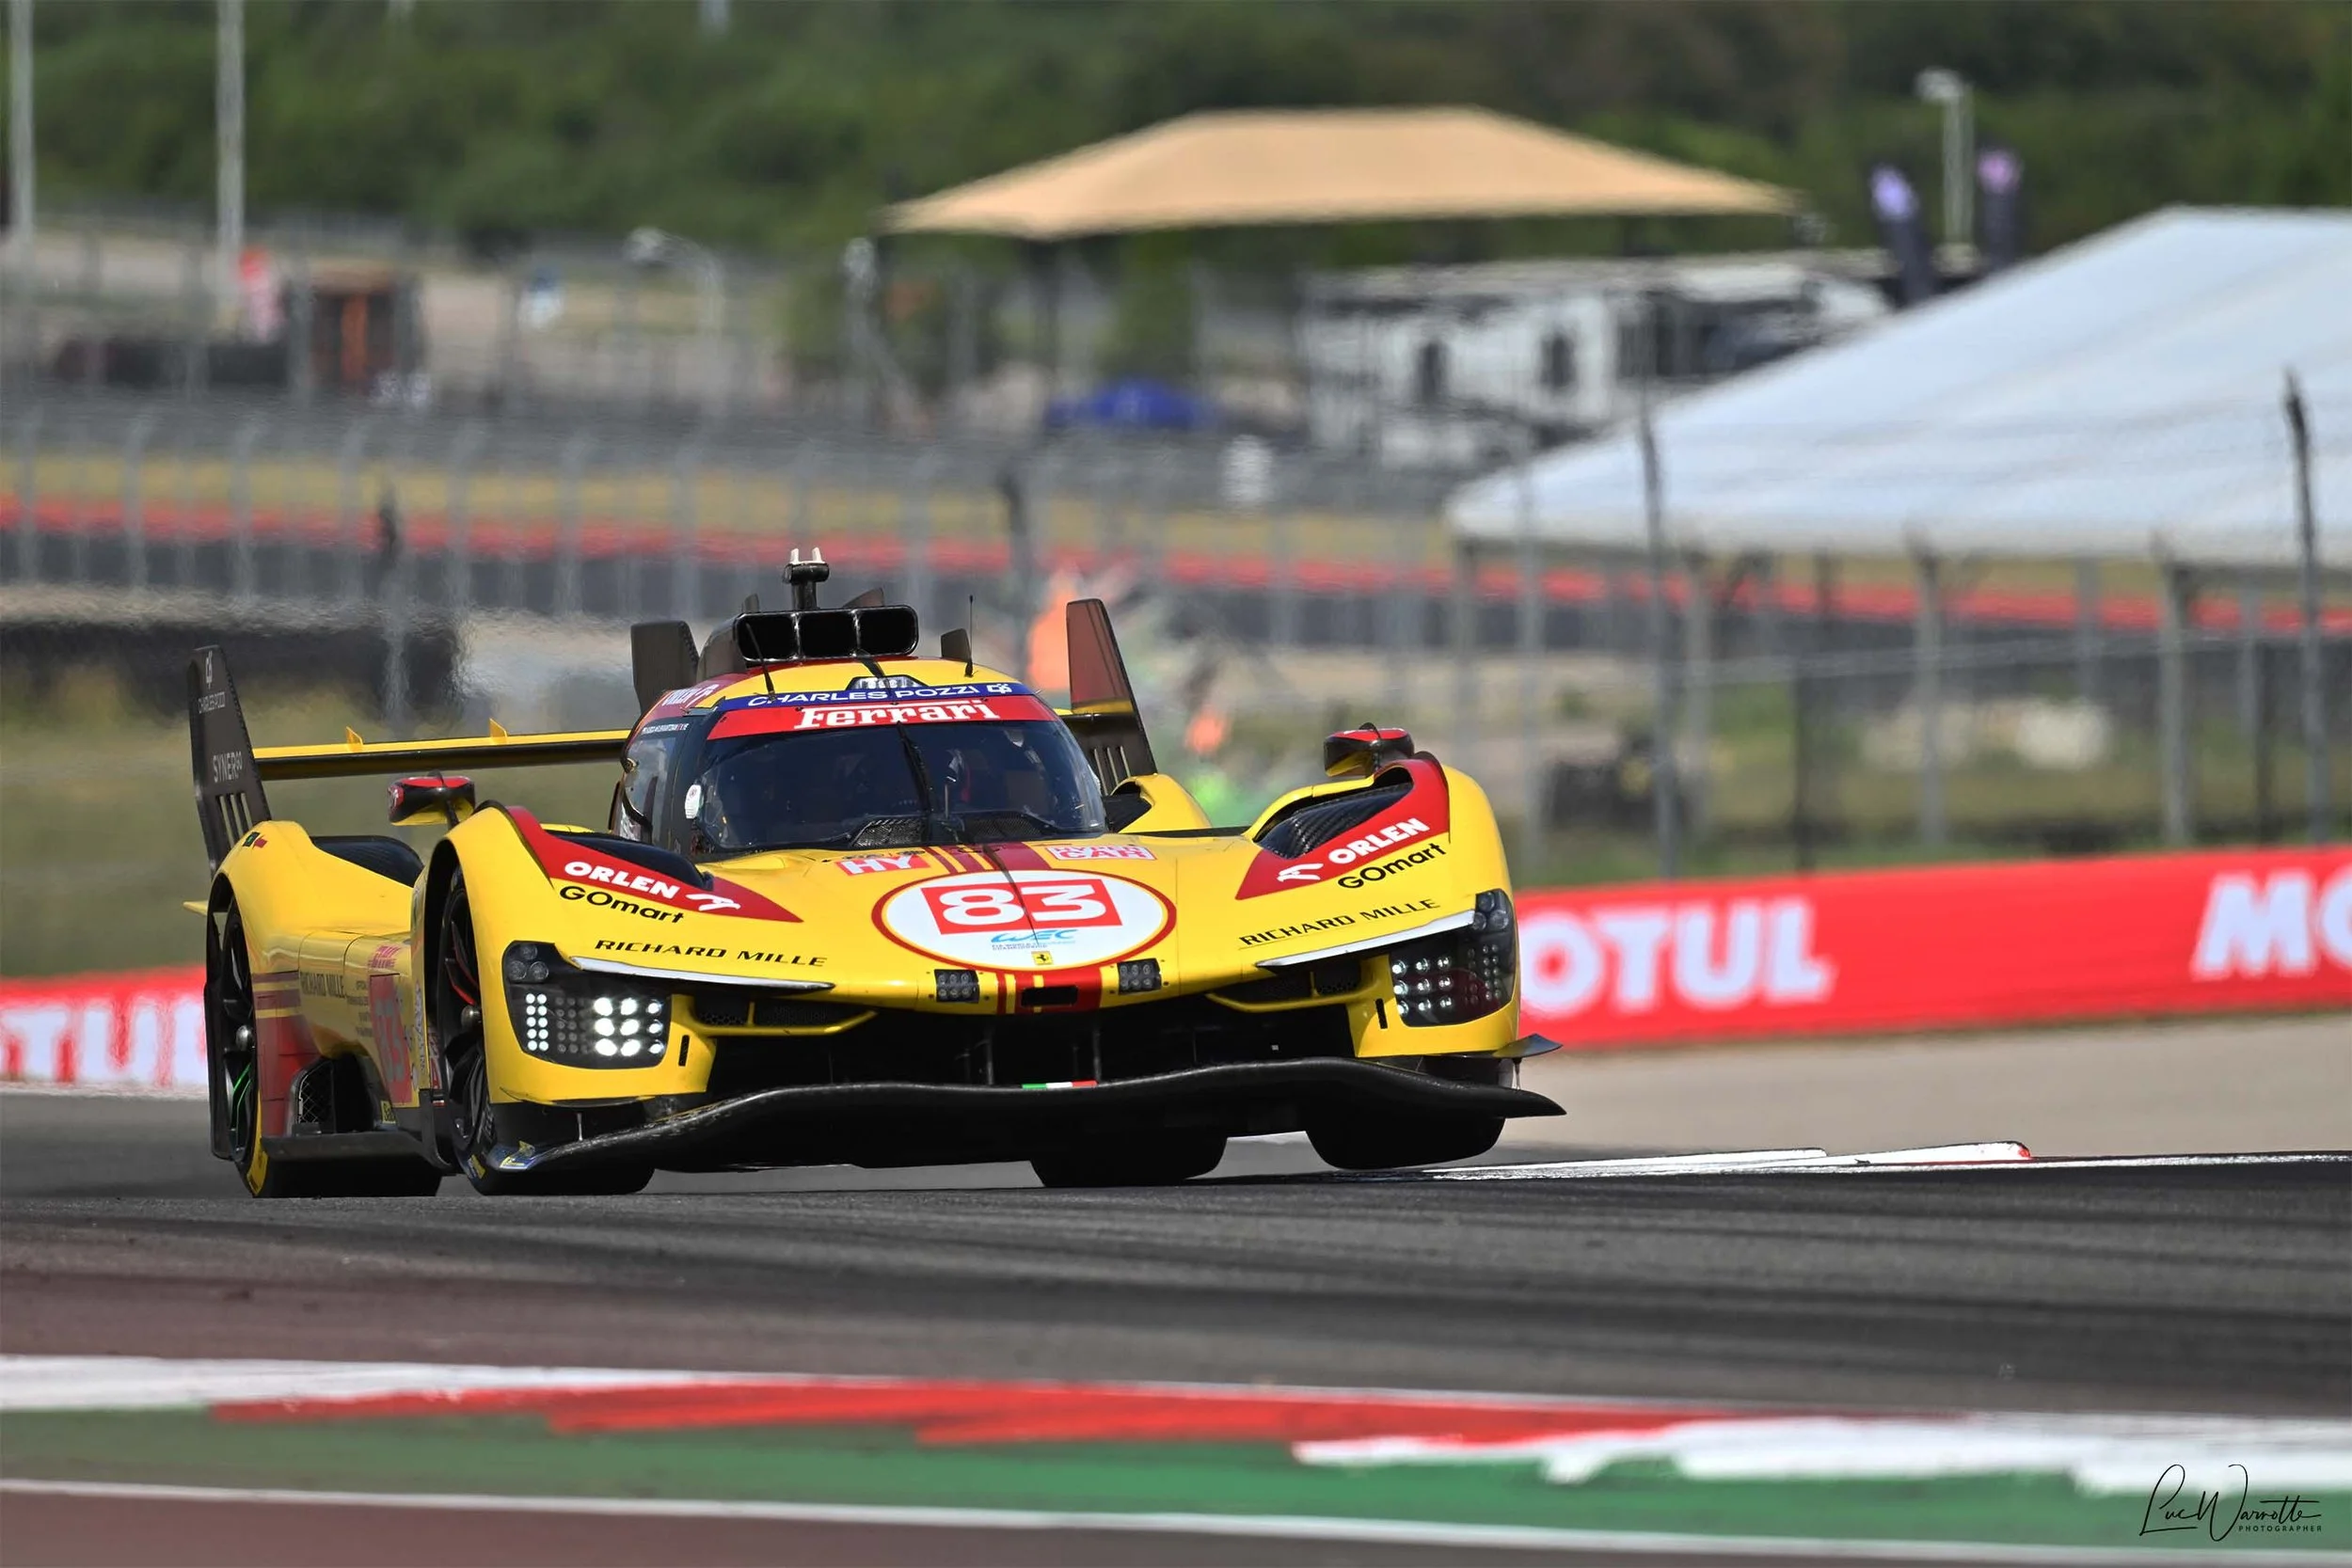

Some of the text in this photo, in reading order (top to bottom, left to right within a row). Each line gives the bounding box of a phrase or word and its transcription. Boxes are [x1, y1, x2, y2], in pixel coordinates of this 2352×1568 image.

[747, 690, 889, 706] CHARLES
[895, 686, 980, 699] POZZI
[793, 700, 1000, 729] Ferrari
[1328, 817, 1430, 864] ORLEN
[564, 861, 680, 899] ORLEN
[840, 855, 914, 875] HY
[1337, 843, 1447, 889] GOmart
[559, 885, 684, 924] GOmart
[939, 883, 1107, 927] 83
[1238, 898, 1441, 946] RICHARD MILLE
[595, 940, 828, 967] RICHARD MILLE
[991, 928, 1078, 942] WEC
[0, 997, 208, 1086] TUL
